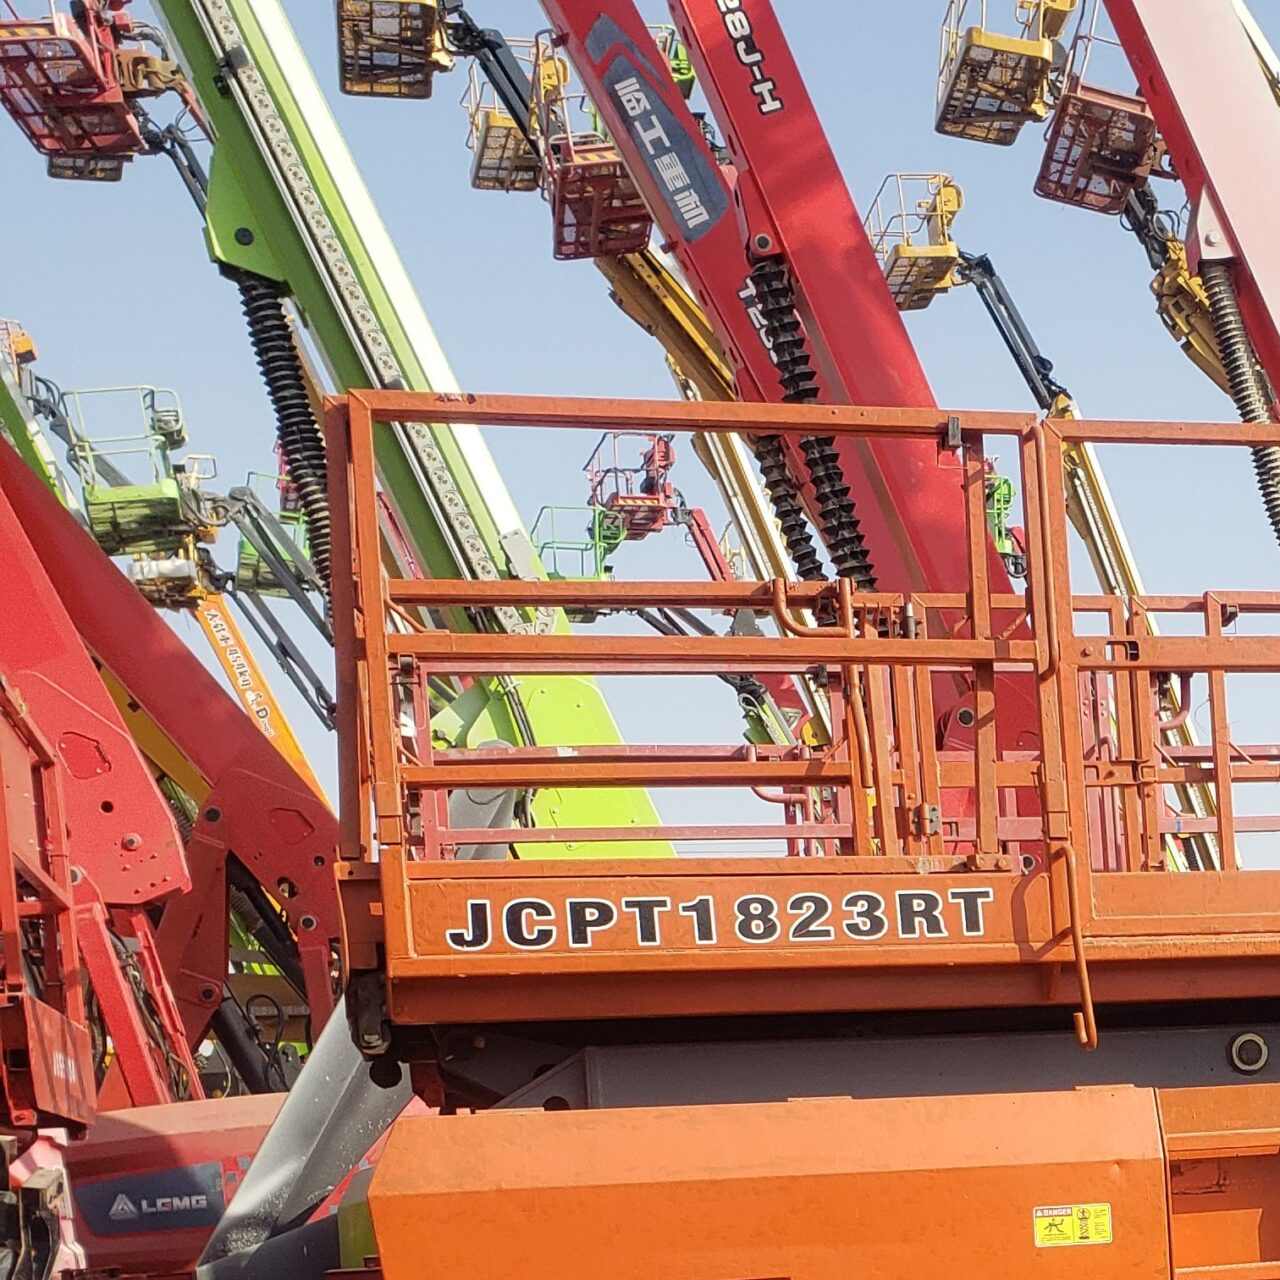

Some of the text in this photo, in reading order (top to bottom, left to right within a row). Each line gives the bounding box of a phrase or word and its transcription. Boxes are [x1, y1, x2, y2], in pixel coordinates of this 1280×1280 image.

[613, 76, 710, 229] 临工重机
[446, 888, 993, 951] JCPT1823RT
[141, 1195, 207, 1213] LGMG
